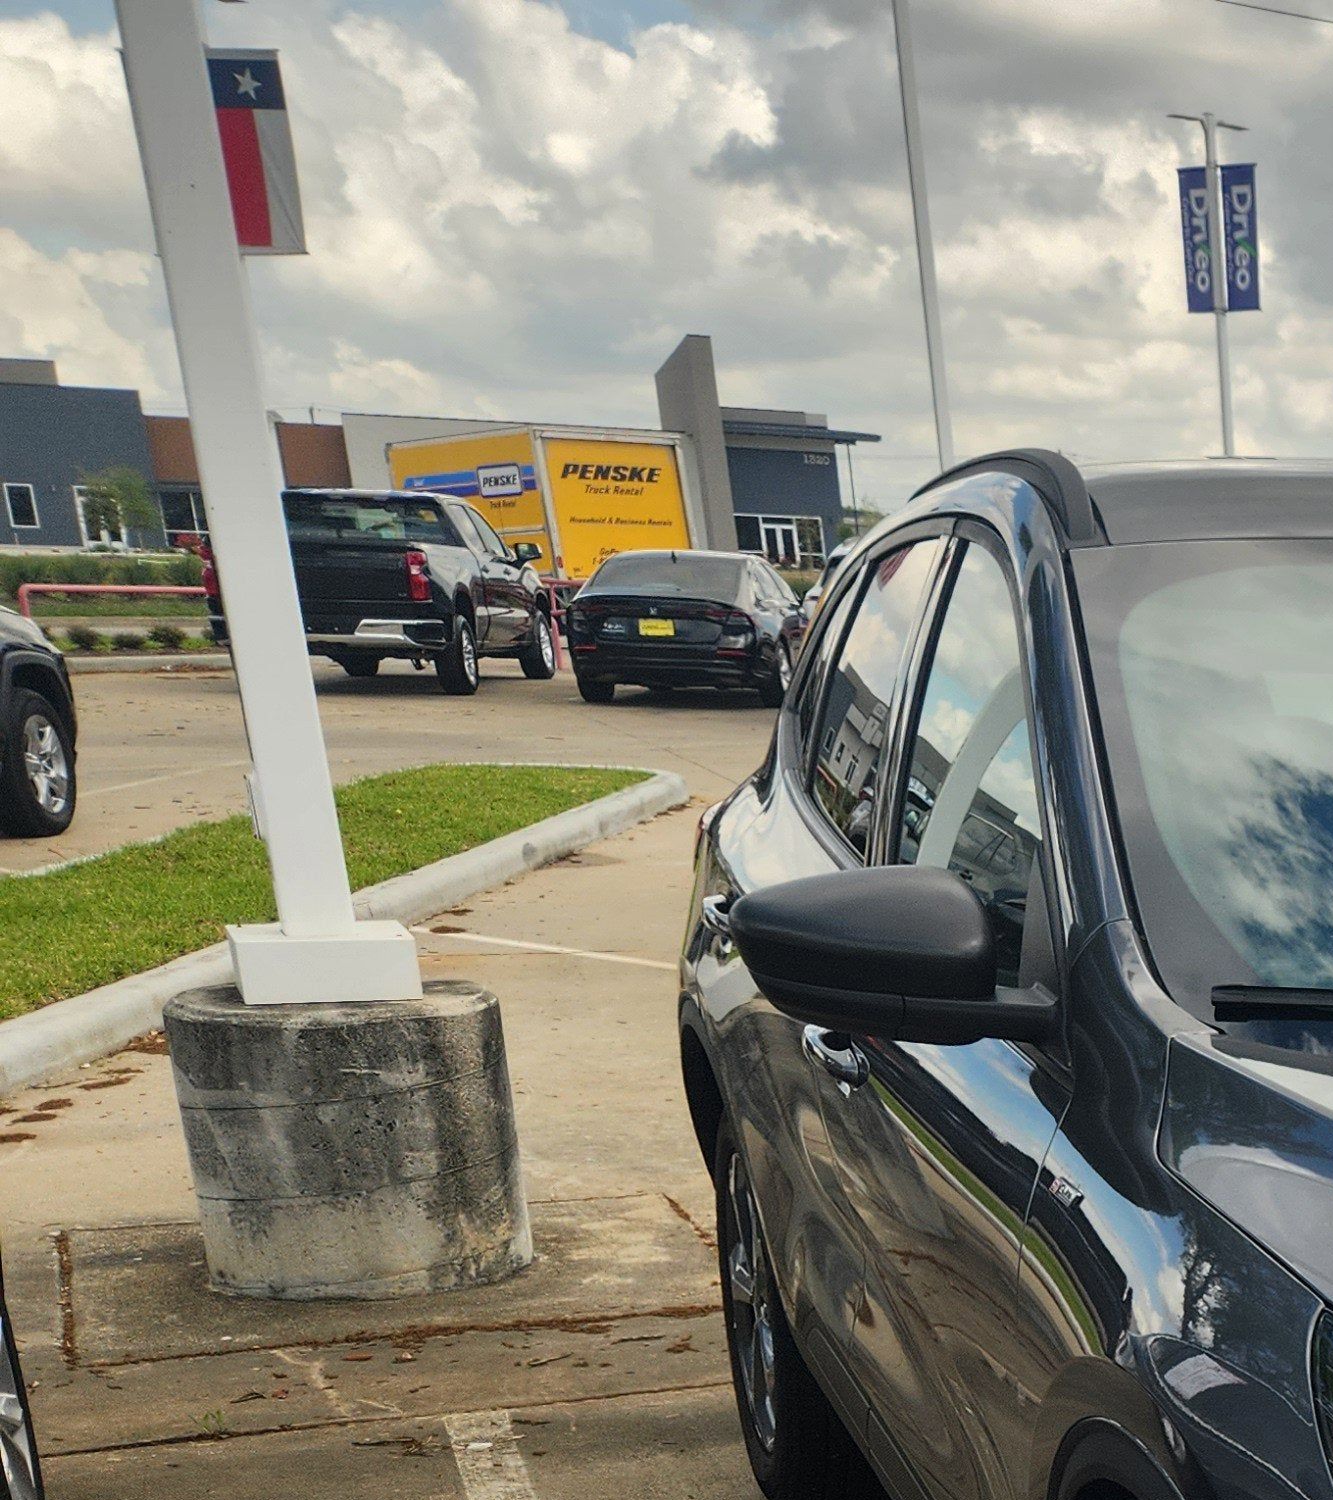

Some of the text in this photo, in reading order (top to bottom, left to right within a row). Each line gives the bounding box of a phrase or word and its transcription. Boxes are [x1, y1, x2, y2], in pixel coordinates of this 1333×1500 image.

[560, 463, 662, 483] PENSKE
[482, 474, 518, 488] PENSKE
[584, 484, 644, 496] Truck Rental
